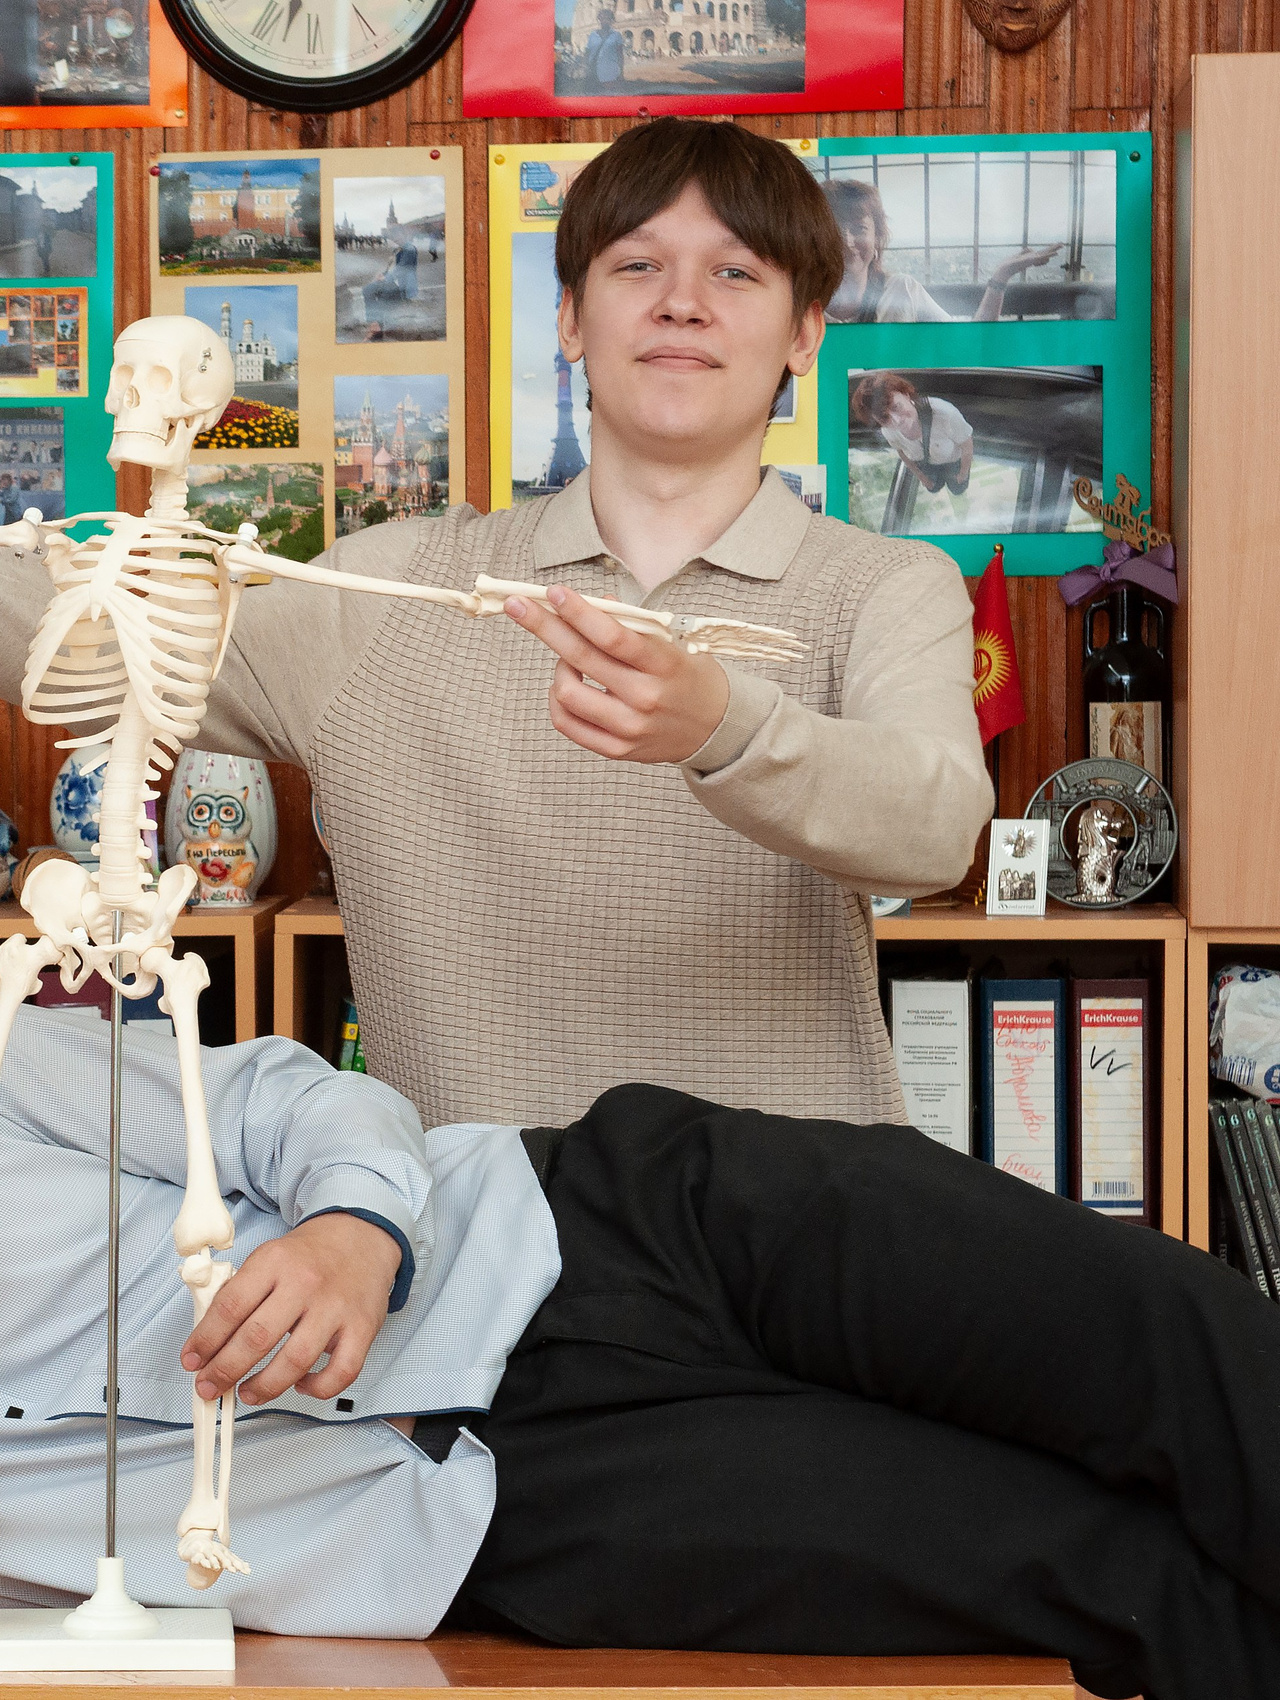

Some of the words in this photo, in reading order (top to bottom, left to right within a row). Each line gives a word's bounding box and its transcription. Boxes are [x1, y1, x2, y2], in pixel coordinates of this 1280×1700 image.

[997, 1014, 1052, 1024] ErichKrause
[1084, 1013, 1139, 1023] ErichKrause
[1230, 1114, 1240, 1126] 6
[1246, 1108, 1256, 1120] 6
[1264, 1114, 1274, 1126] 6
[1218, 1115, 1226, 1127] 6
